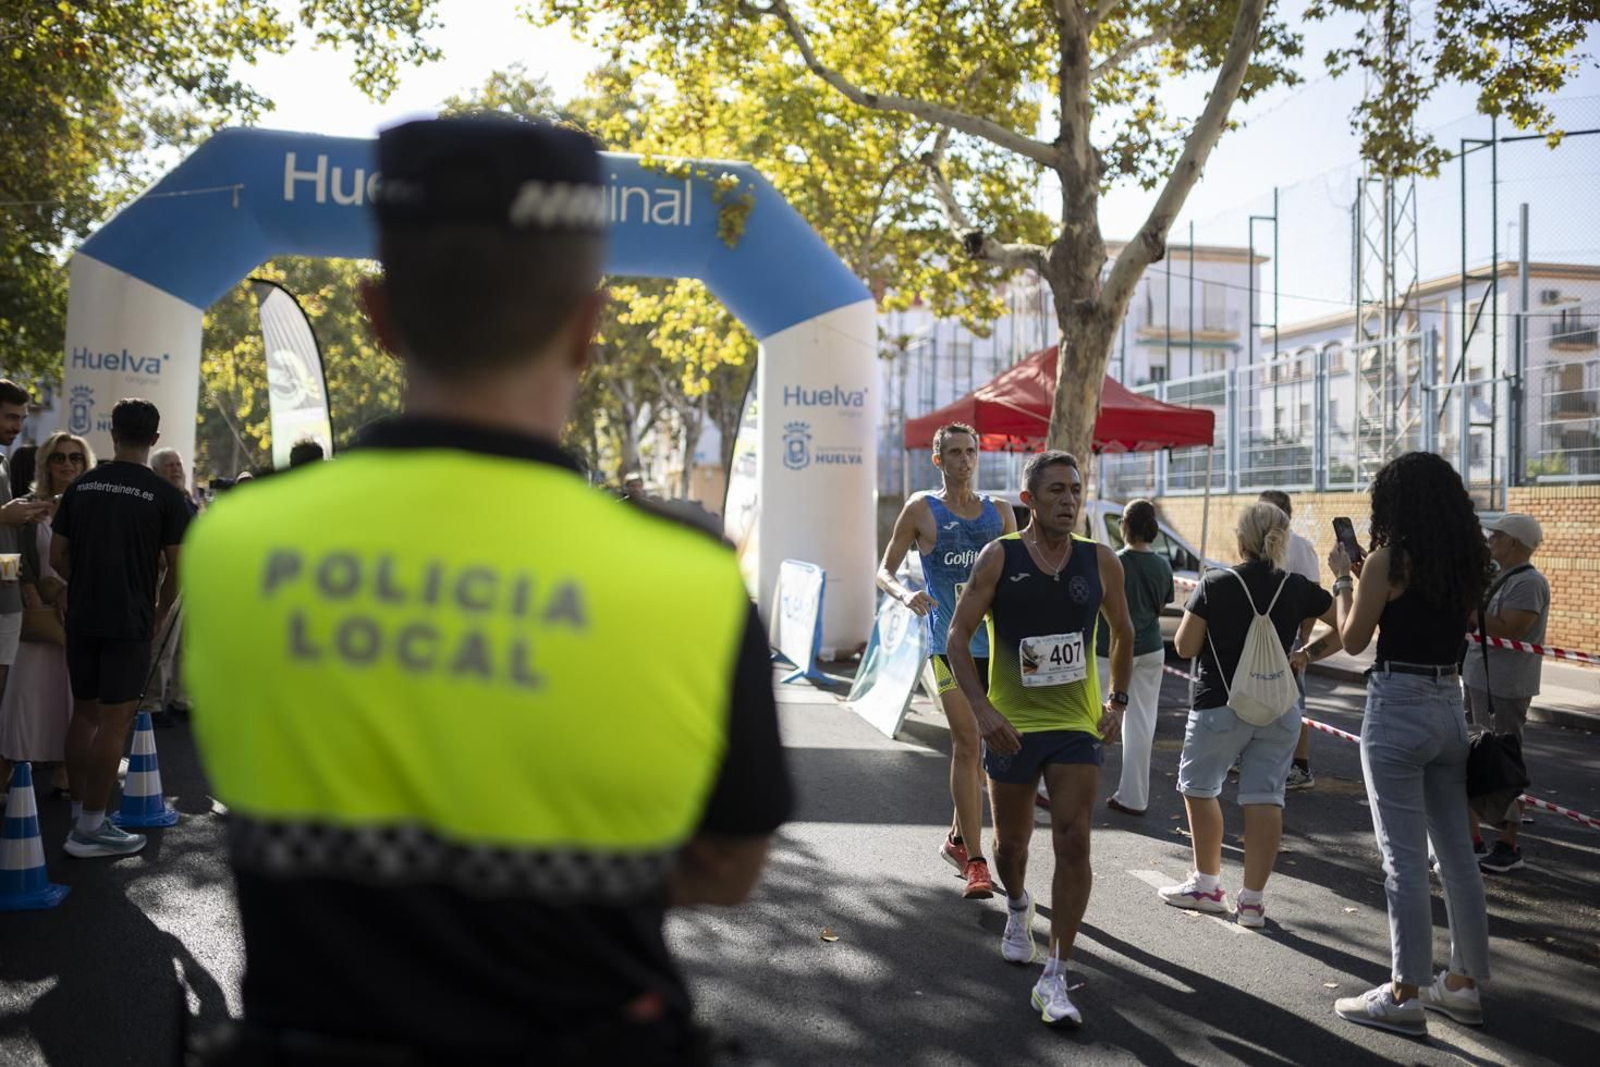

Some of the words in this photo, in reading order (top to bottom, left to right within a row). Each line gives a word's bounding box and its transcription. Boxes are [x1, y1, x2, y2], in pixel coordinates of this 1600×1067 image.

[599, 171, 692, 226] inal
[72, 346, 162, 375] Huelva
[783, 384, 864, 408] Huelva
[815, 453, 863, 465] HUELVA
[77, 481, 154, 501] mastertrainers.es
[263, 549, 590, 631] POLICIA
[287, 607, 548, 690] LOCAL
[1050, 641, 1082, 666] 407
